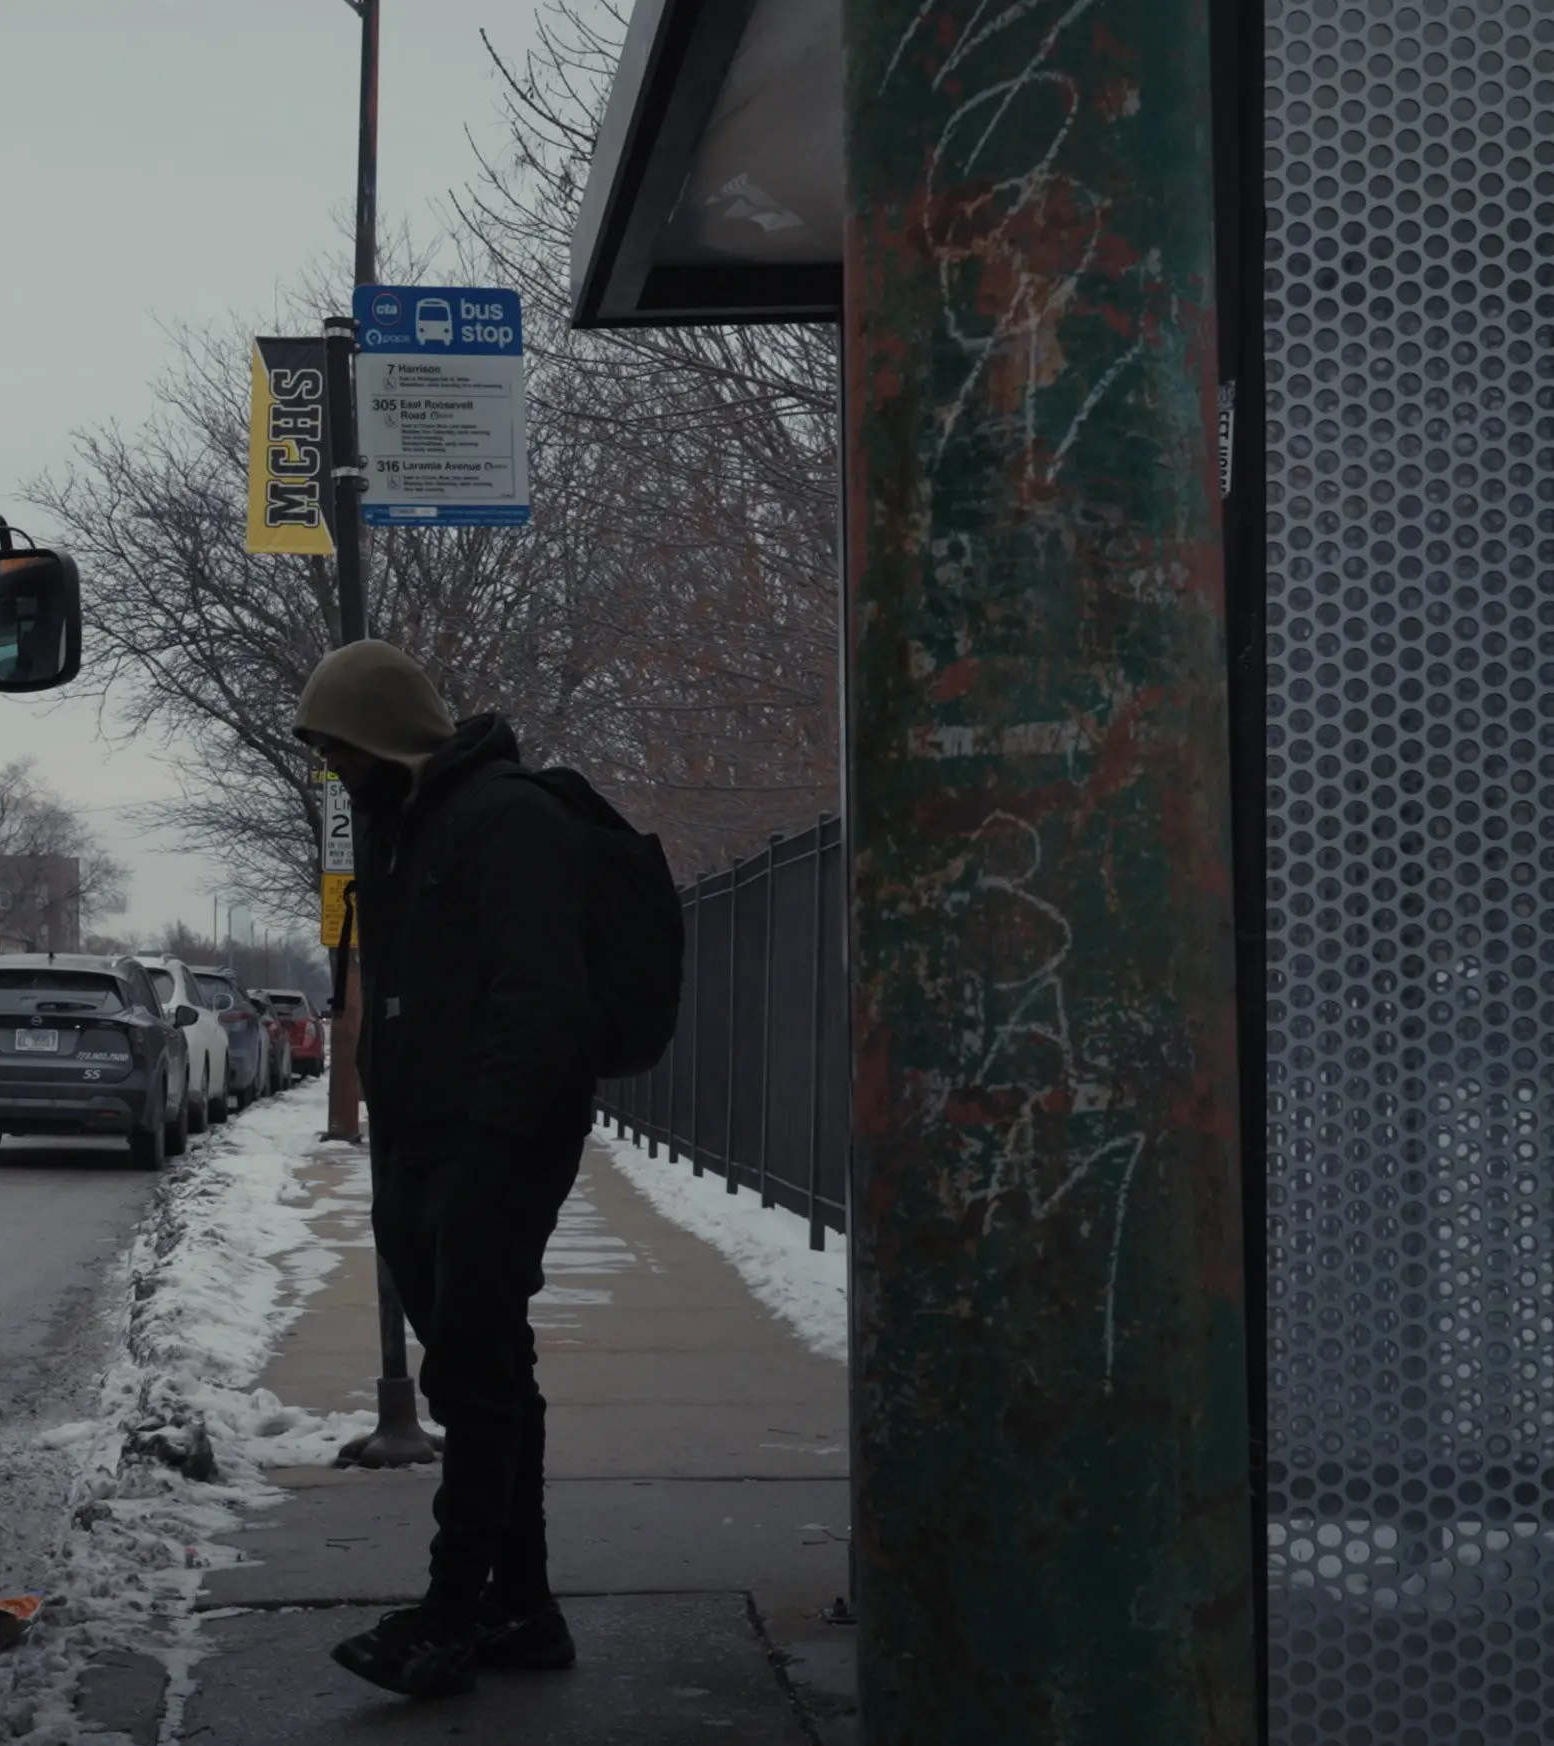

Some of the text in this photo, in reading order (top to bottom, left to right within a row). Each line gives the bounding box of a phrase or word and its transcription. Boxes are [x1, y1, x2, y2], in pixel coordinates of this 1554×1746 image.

[375, 303, 399, 316] cta
[460, 297, 504, 321] bus
[461, 322, 514, 349] stop
[387, 364, 441, 375] 7 Harrison
[372, 399, 474, 411] 305 East Roosevelt
[400, 411, 427, 420] Road
[265, 367, 324, 528] MCHS
[377, 460, 400, 473] 316
[402, 461, 442, 471] Laramie
[445, 462, 482, 471] Avenue
[331, 814, 351, 838] 2
